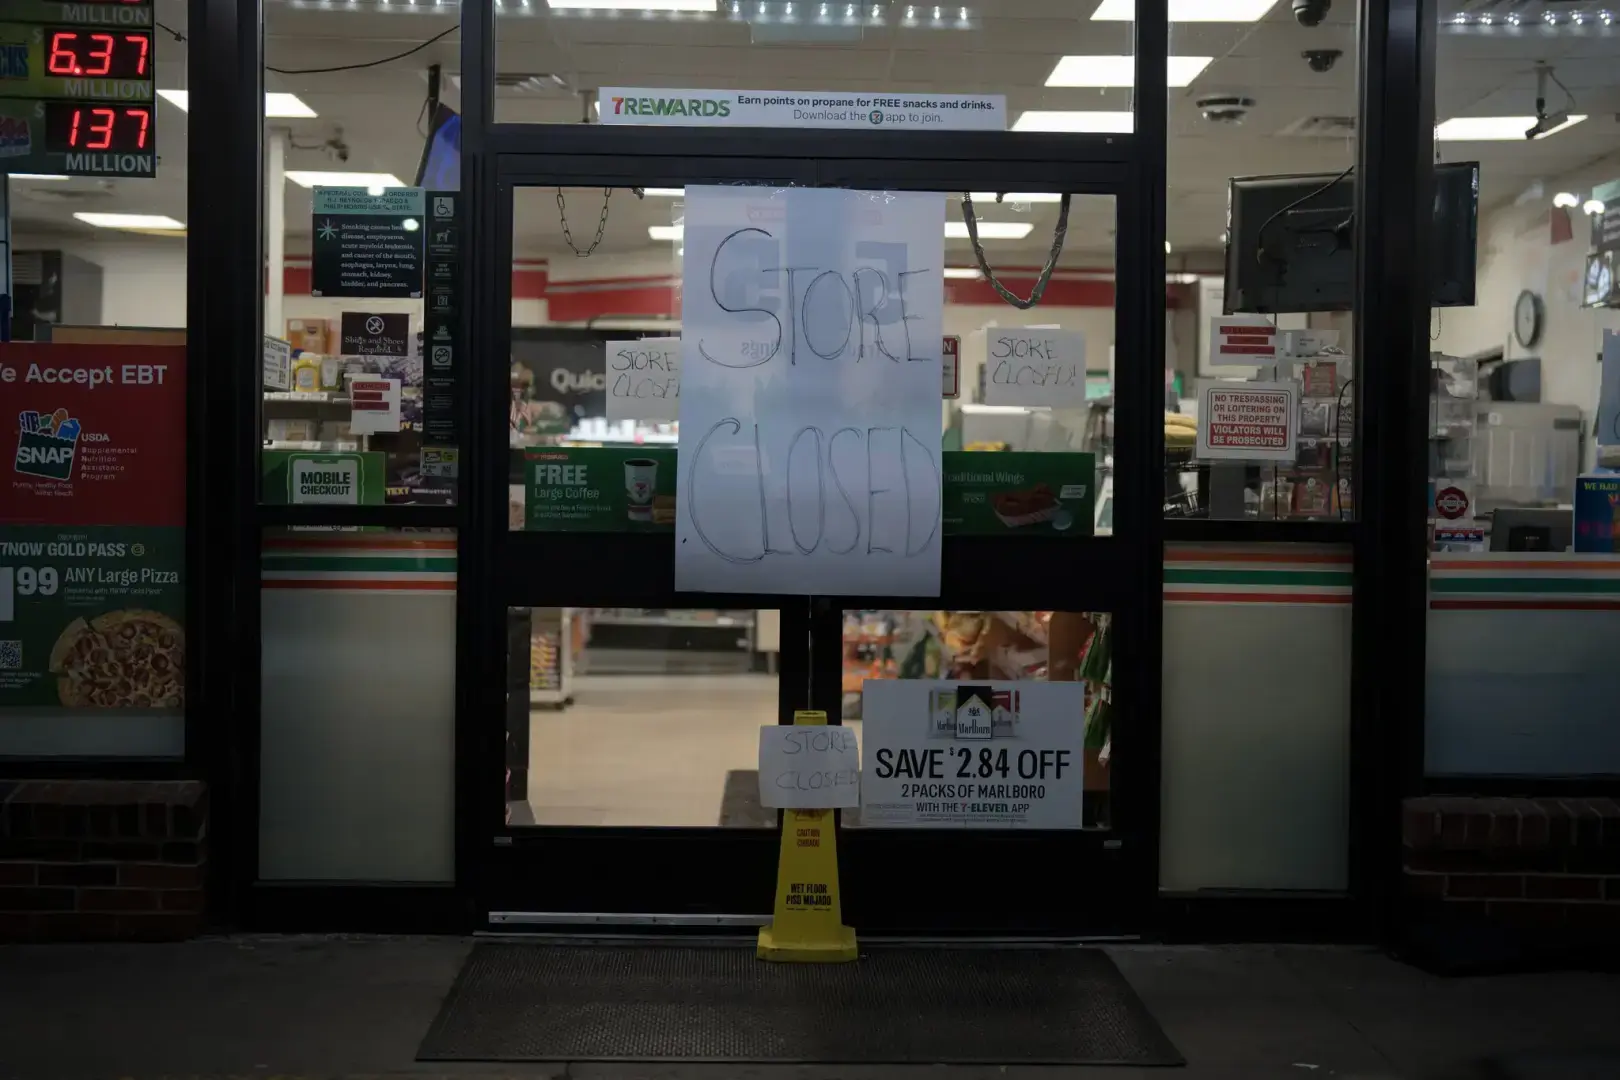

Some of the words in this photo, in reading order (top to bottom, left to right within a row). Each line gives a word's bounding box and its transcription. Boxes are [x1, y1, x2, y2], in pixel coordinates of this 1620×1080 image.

[62, 5, 149, 24] MILLION
[49, 32, 149, 75] 6.37
[64, 79, 150, 98] MILLION
[611, 96, 731, 117] 7REWARDS
[738, 95, 761, 104] Earn
[763, 96, 795, 106] points
[812, 98, 854, 109] propane
[857, 97, 871, 106] for
[873, 98, 901, 107] FREE
[903, 98, 938, 108] snacks
[940, 100, 959, 109] and
[961, 100, 995, 110] drinks.
[793, 109, 847, 121] Download
[850, 110, 867, 121] the
[886, 114, 906, 124] app
[909, 113, 919, 122] to
[921, 113, 944, 124] join.
[69, 108, 149, 148] 137
[66, 153, 151, 172] MILLION
[341, 223, 370, 231] Smoking
[697, 226, 934, 369] STORE
[368, 336, 381, 344] and
[991, 336, 1059, 360] STORE
[611, 349, 678, 372] STORE
[0, 362, 17, 383] e
[25, 363, 114, 390] Accept
[121, 364, 168, 385] EBT
[1214, 394, 1227, 402] NO
[1229, 395, 1285, 404] TRESPASSING
[1213, 404, 1225, 412] OR
[1227, 404, 1271, 413] LOITERING
[1273, 406, 1285, 414] ON
[1218, 414, 1236, 422] THIS
[1238, 414, 1281, 423] PROPERTY
[81, 433, 111, 442] USDA
[1213, 424, 1261, 434] VIOLATORS
[1263, 426, 1284, 435] WILL
[1213, 436, 1225, 444] BE
[1226, 436, 1284, 445] PROSECUTED
[17, 446, 74, 464] SNAP
[300, 471, 351, 484] MOBILE
[534, 464, 588, 485] FREE
[995, 472, 1025, 485] Wings
[300, 485, 351, 495] CHECKOUT
[534, 487, 564, 501] Large
[565, 487, 600, 499] Coffee
[686, 416, 942, 566] CLOSED
[0, 542, 43, 557] 7NOW
[47, 542, 86, 557] GOLD
[88, 542, 126, 557] PASS
[16, 566, 59, 596] 99
[64, 567, 95, 583] ANY
[98, 568, 138, 586] Large
[141, 568, 180, 584] Pizza
[782, 730, 859, 754] STORE
[875, 748, 945, 780] SAVE
[1017, 749, 1071, 780] OFF
[775, 769, 859, 791] CLOSED
[901, 783, 909, 798] 2
[912, 784, 955, 798] PACKS
[957, 784, 975, 798] OF
[978, 784, 1045, 799] MARLBORO
[916, 802, 940, 812] WITH
[942, 802, 958, 812] THE
[1011, 803, 1030, 813] APP
[790, 883, 805, 894] WET
[806, 883, 828, 894] FLOOR
[786, 895, 802, 905] PISO
[803, 895, 832, 906] MOJADO
